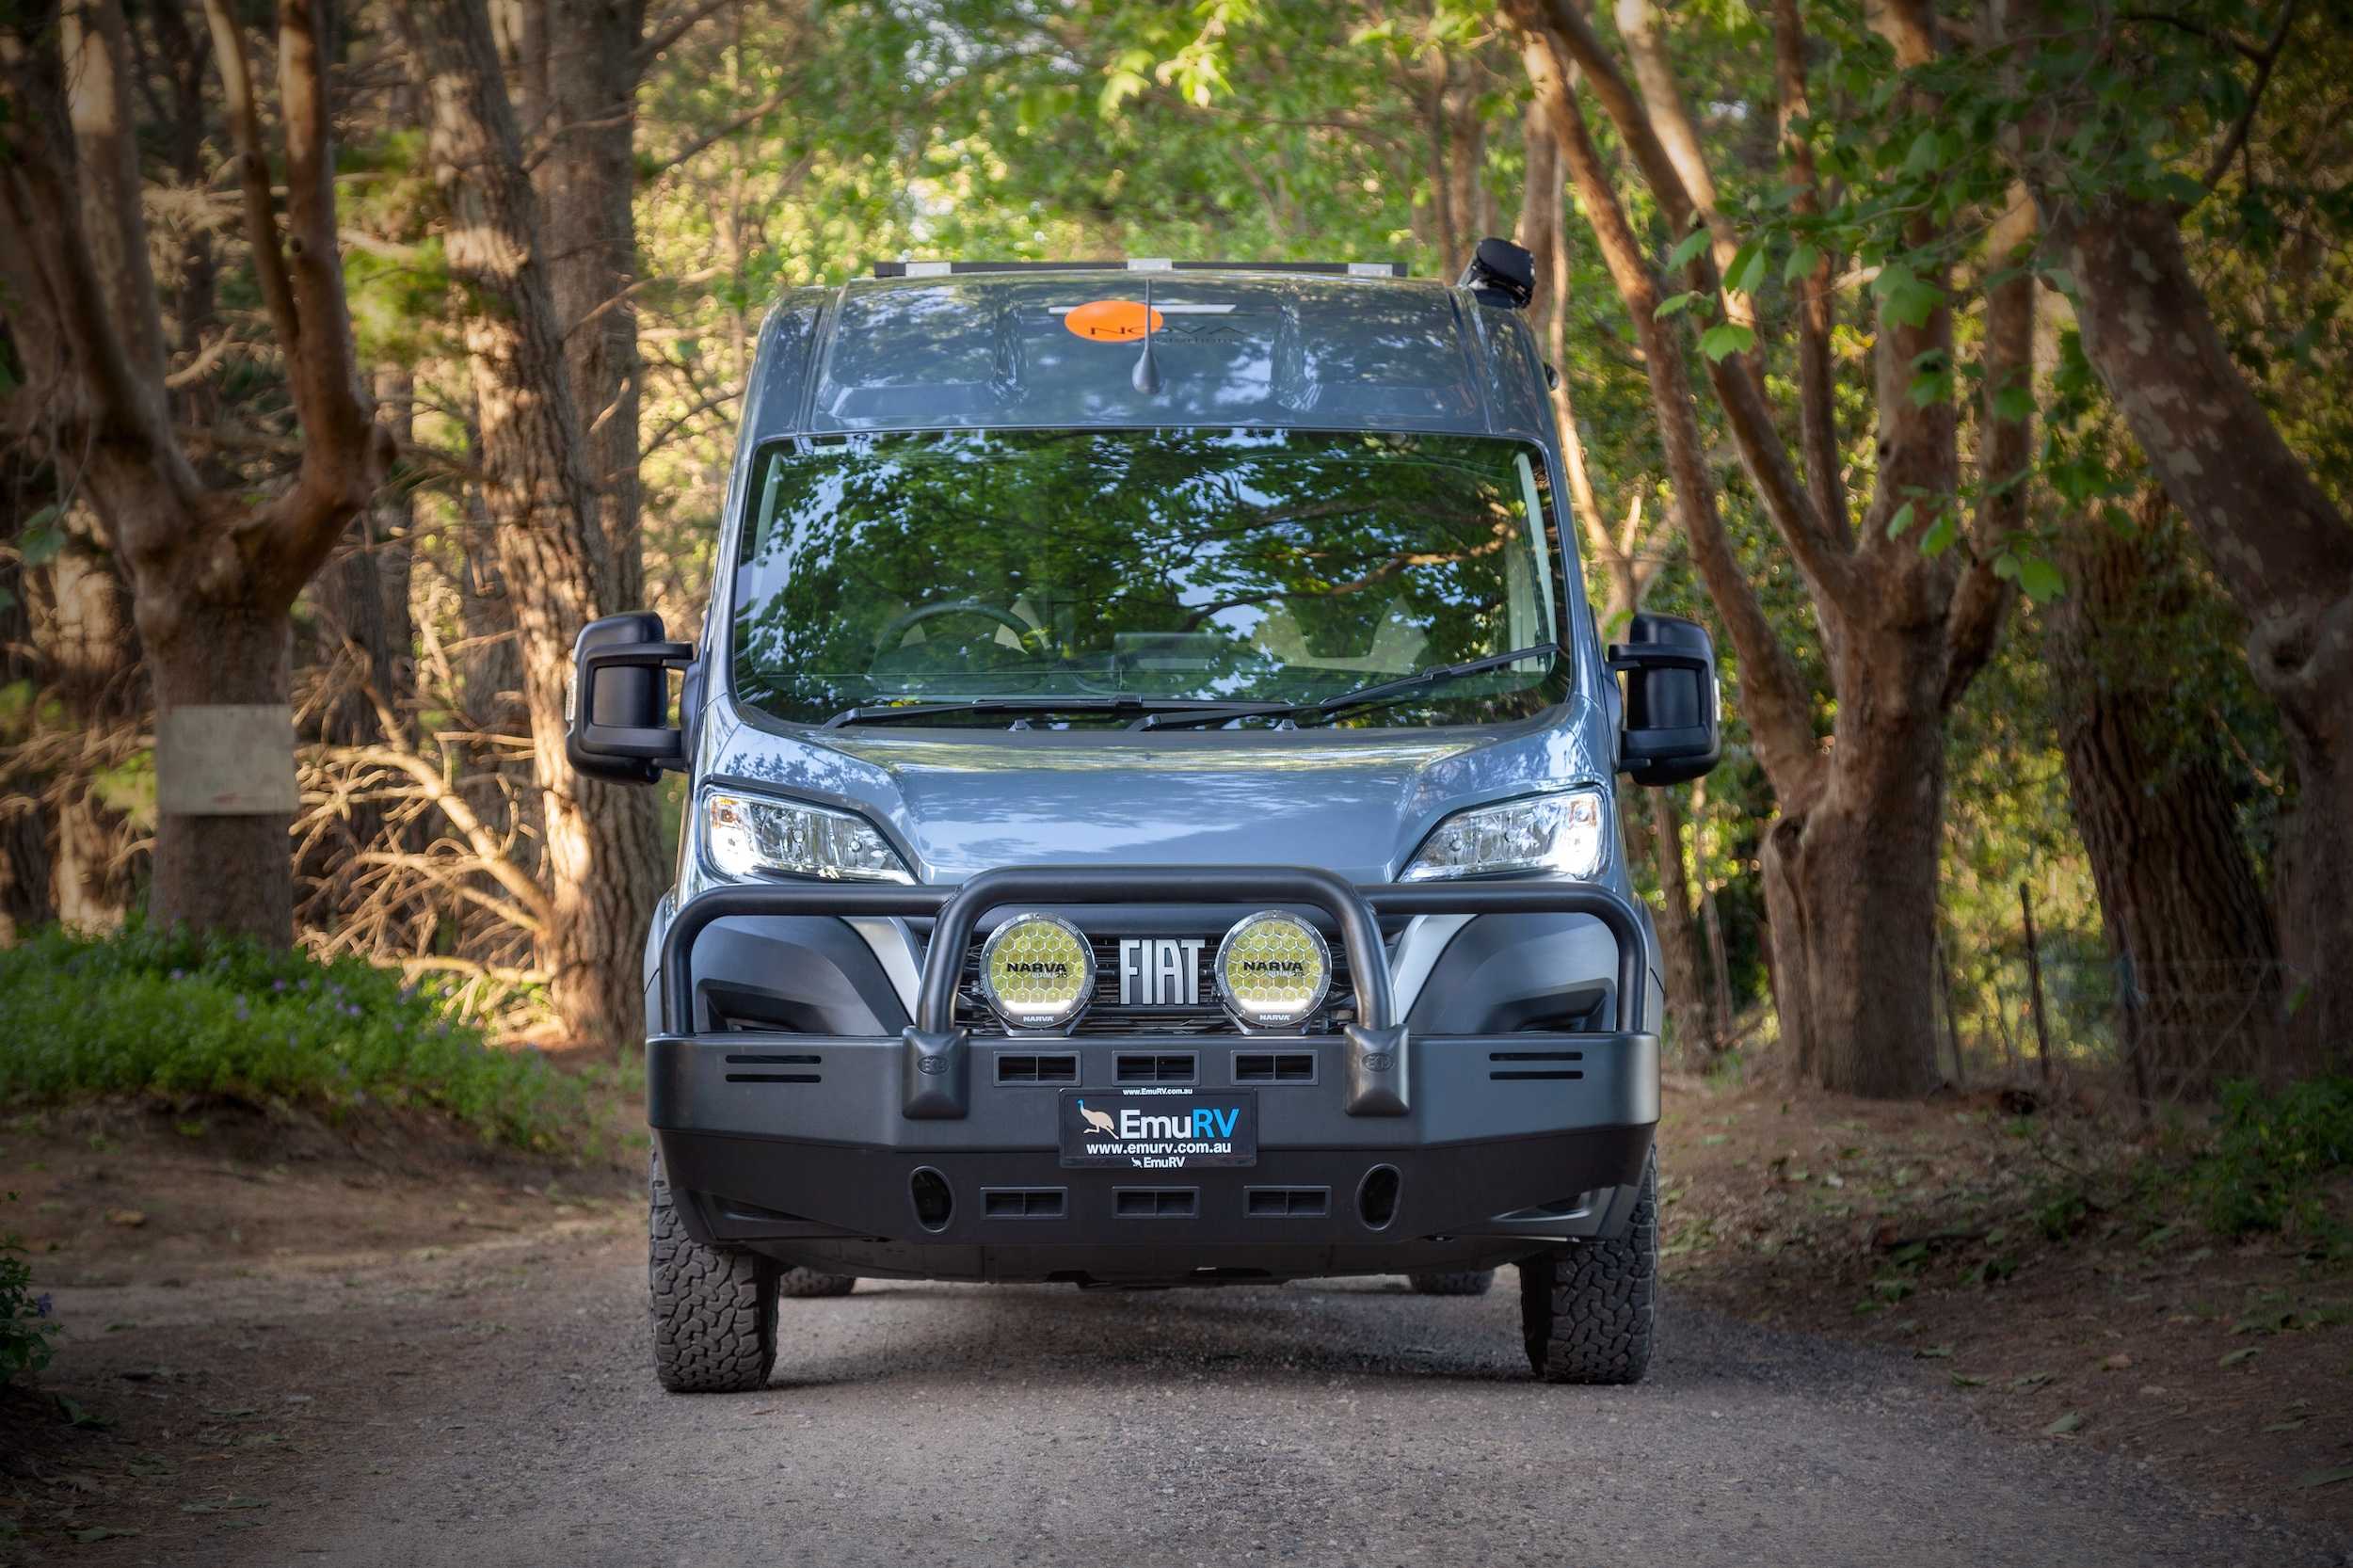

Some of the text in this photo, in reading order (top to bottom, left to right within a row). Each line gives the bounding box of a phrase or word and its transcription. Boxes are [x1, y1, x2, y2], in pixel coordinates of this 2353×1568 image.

[1006, 963, 1067, 973] NARVA
[1243, 961, 1304, 971] NARVA
[1119, 939, 1206, 1005] FIAT
[1022, 1015, 1055, 1023] NARVA
[1122, 1087, 1193, 1096] www.EmuRV.com.au
[1119, 1108, 1241, 1140] EmuRV
[1086, 1142, 1232, 1155] www.emurv.com.au
[1143, 1157, 1186, 1169] EmuRV
